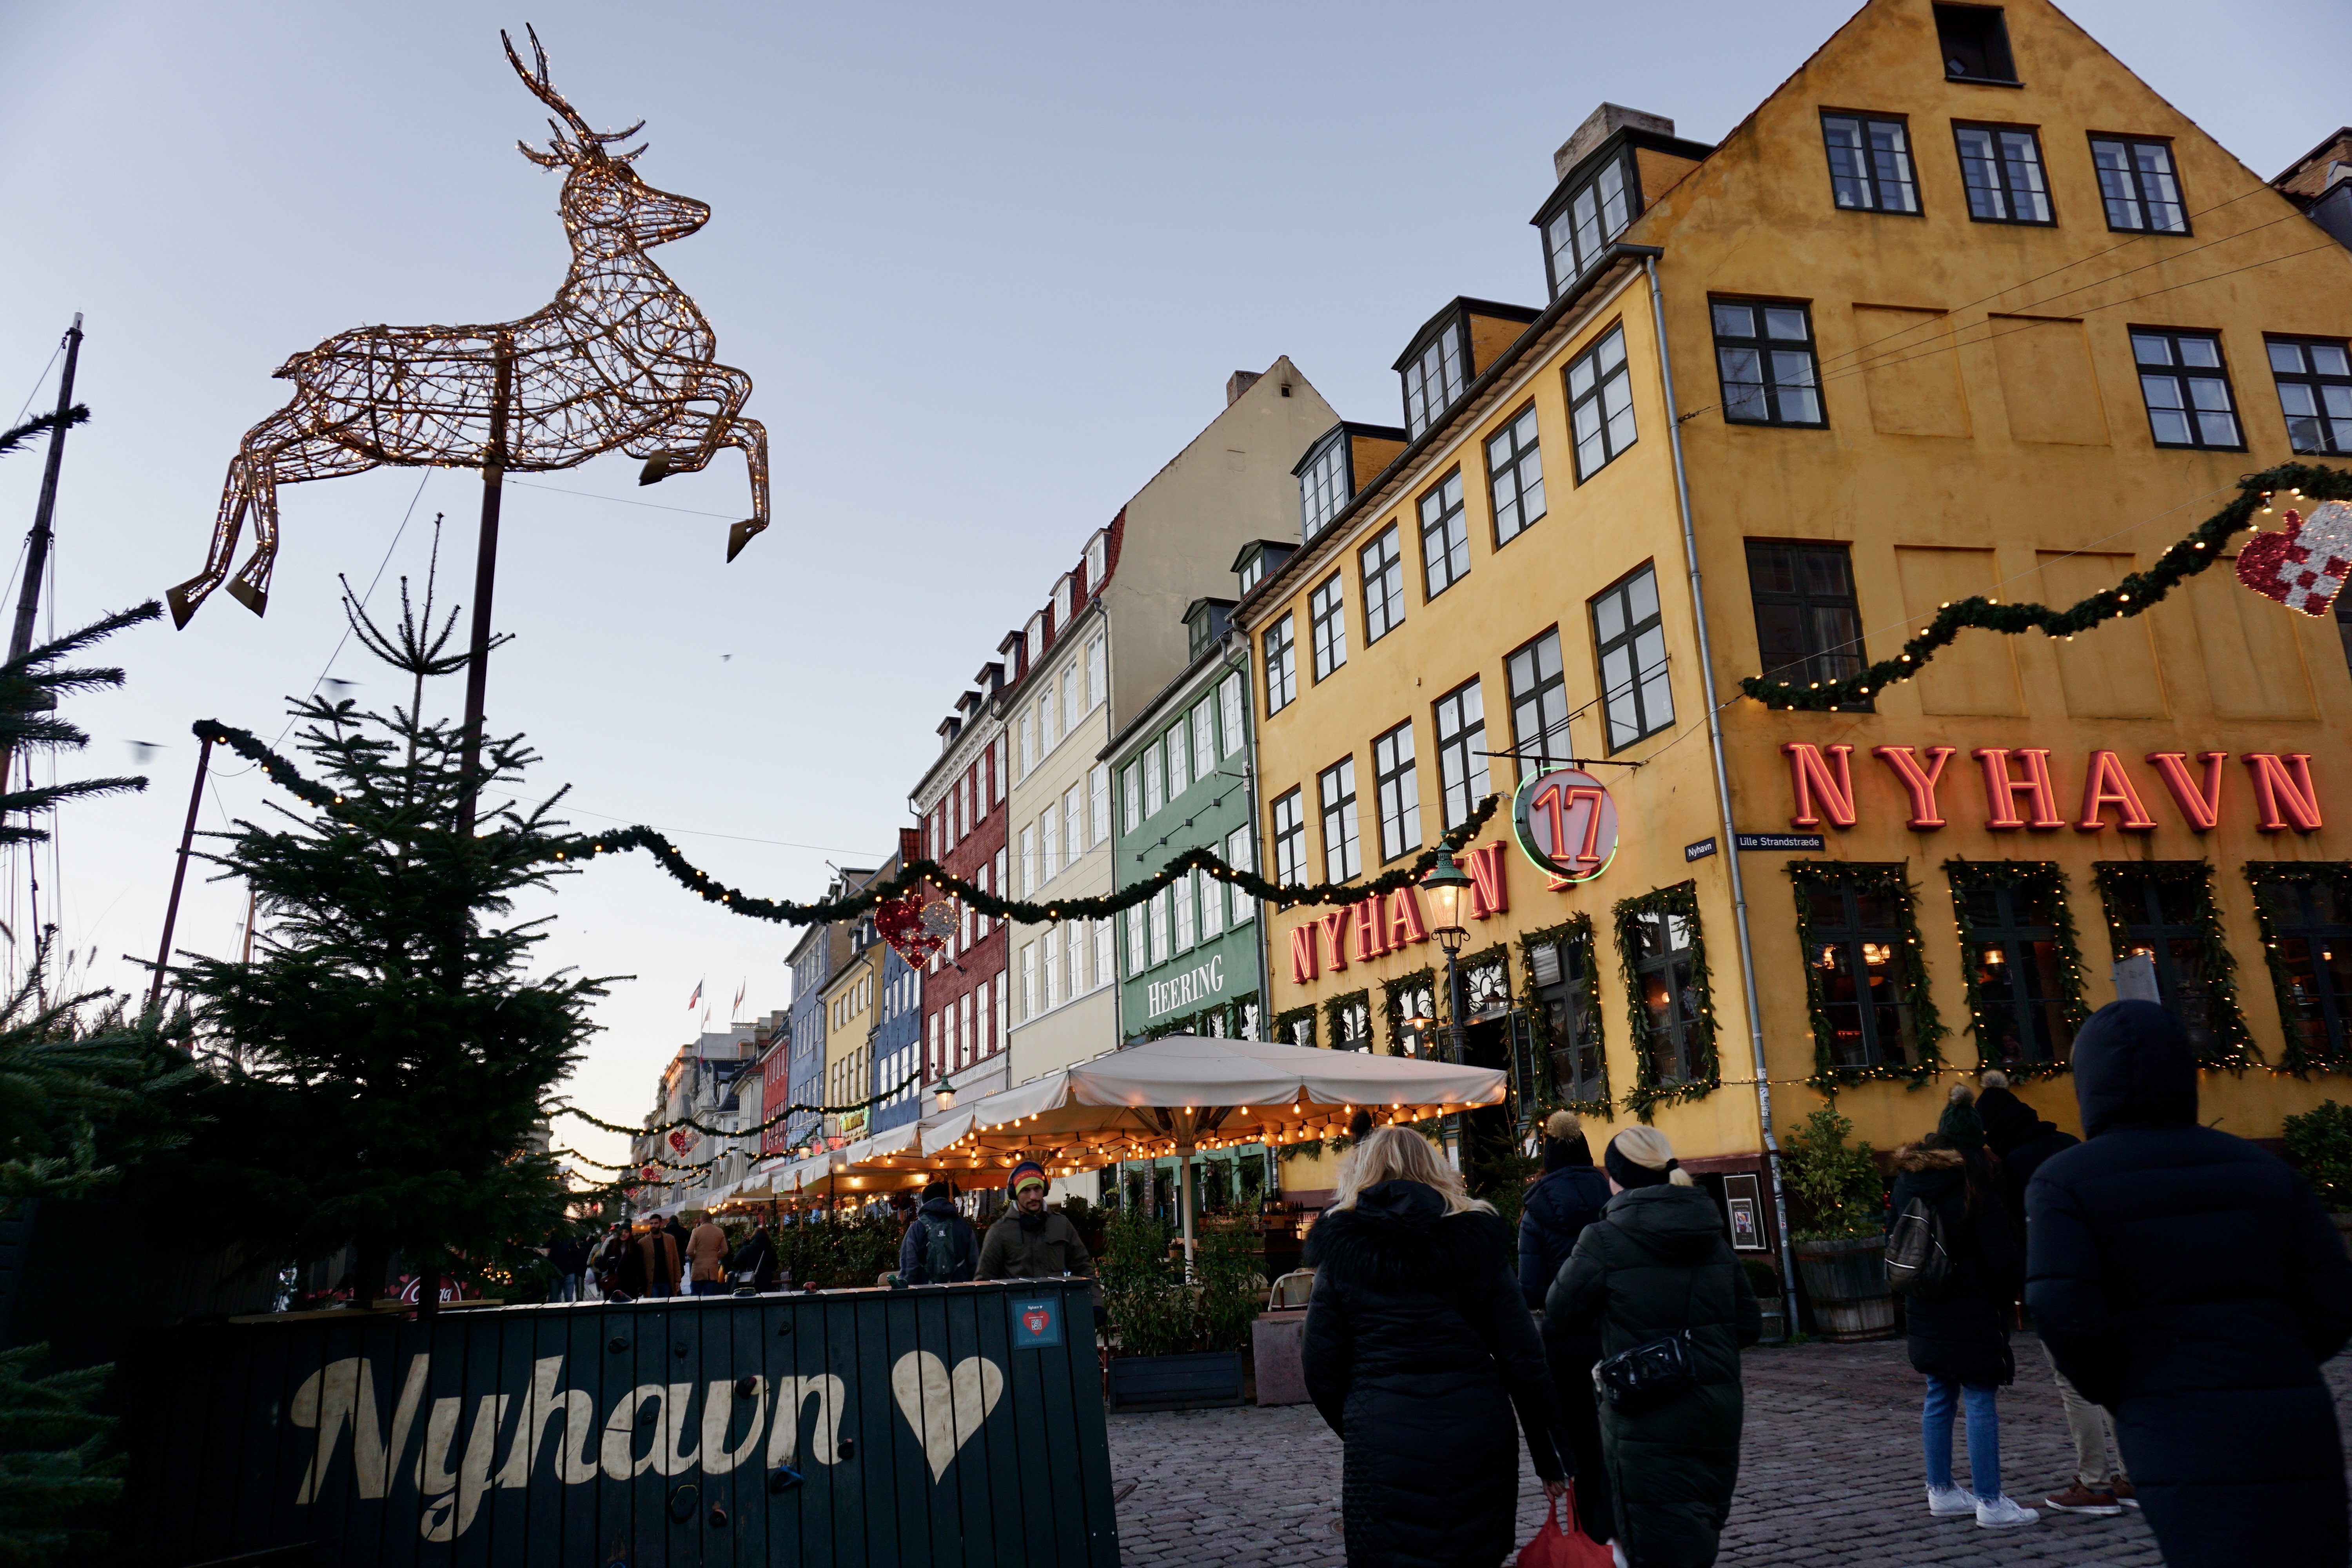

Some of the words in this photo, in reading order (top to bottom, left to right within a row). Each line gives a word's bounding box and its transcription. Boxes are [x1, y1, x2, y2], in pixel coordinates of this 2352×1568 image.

[1780, 742, 2323, 833] NYHAVN
[1532, 784, 1604, 862] 17
[1688, 842, 1712, 857] Nyhavn
[1740, 837, 1758, 846] Lille
[1760, 837, 1820, 846] Strandstræde
[1147, 954, 1224, 1018] HEERING
[1519, 1019, 1526, 1028] 17
[290, 1353, 846, 1543] Nyhavn
